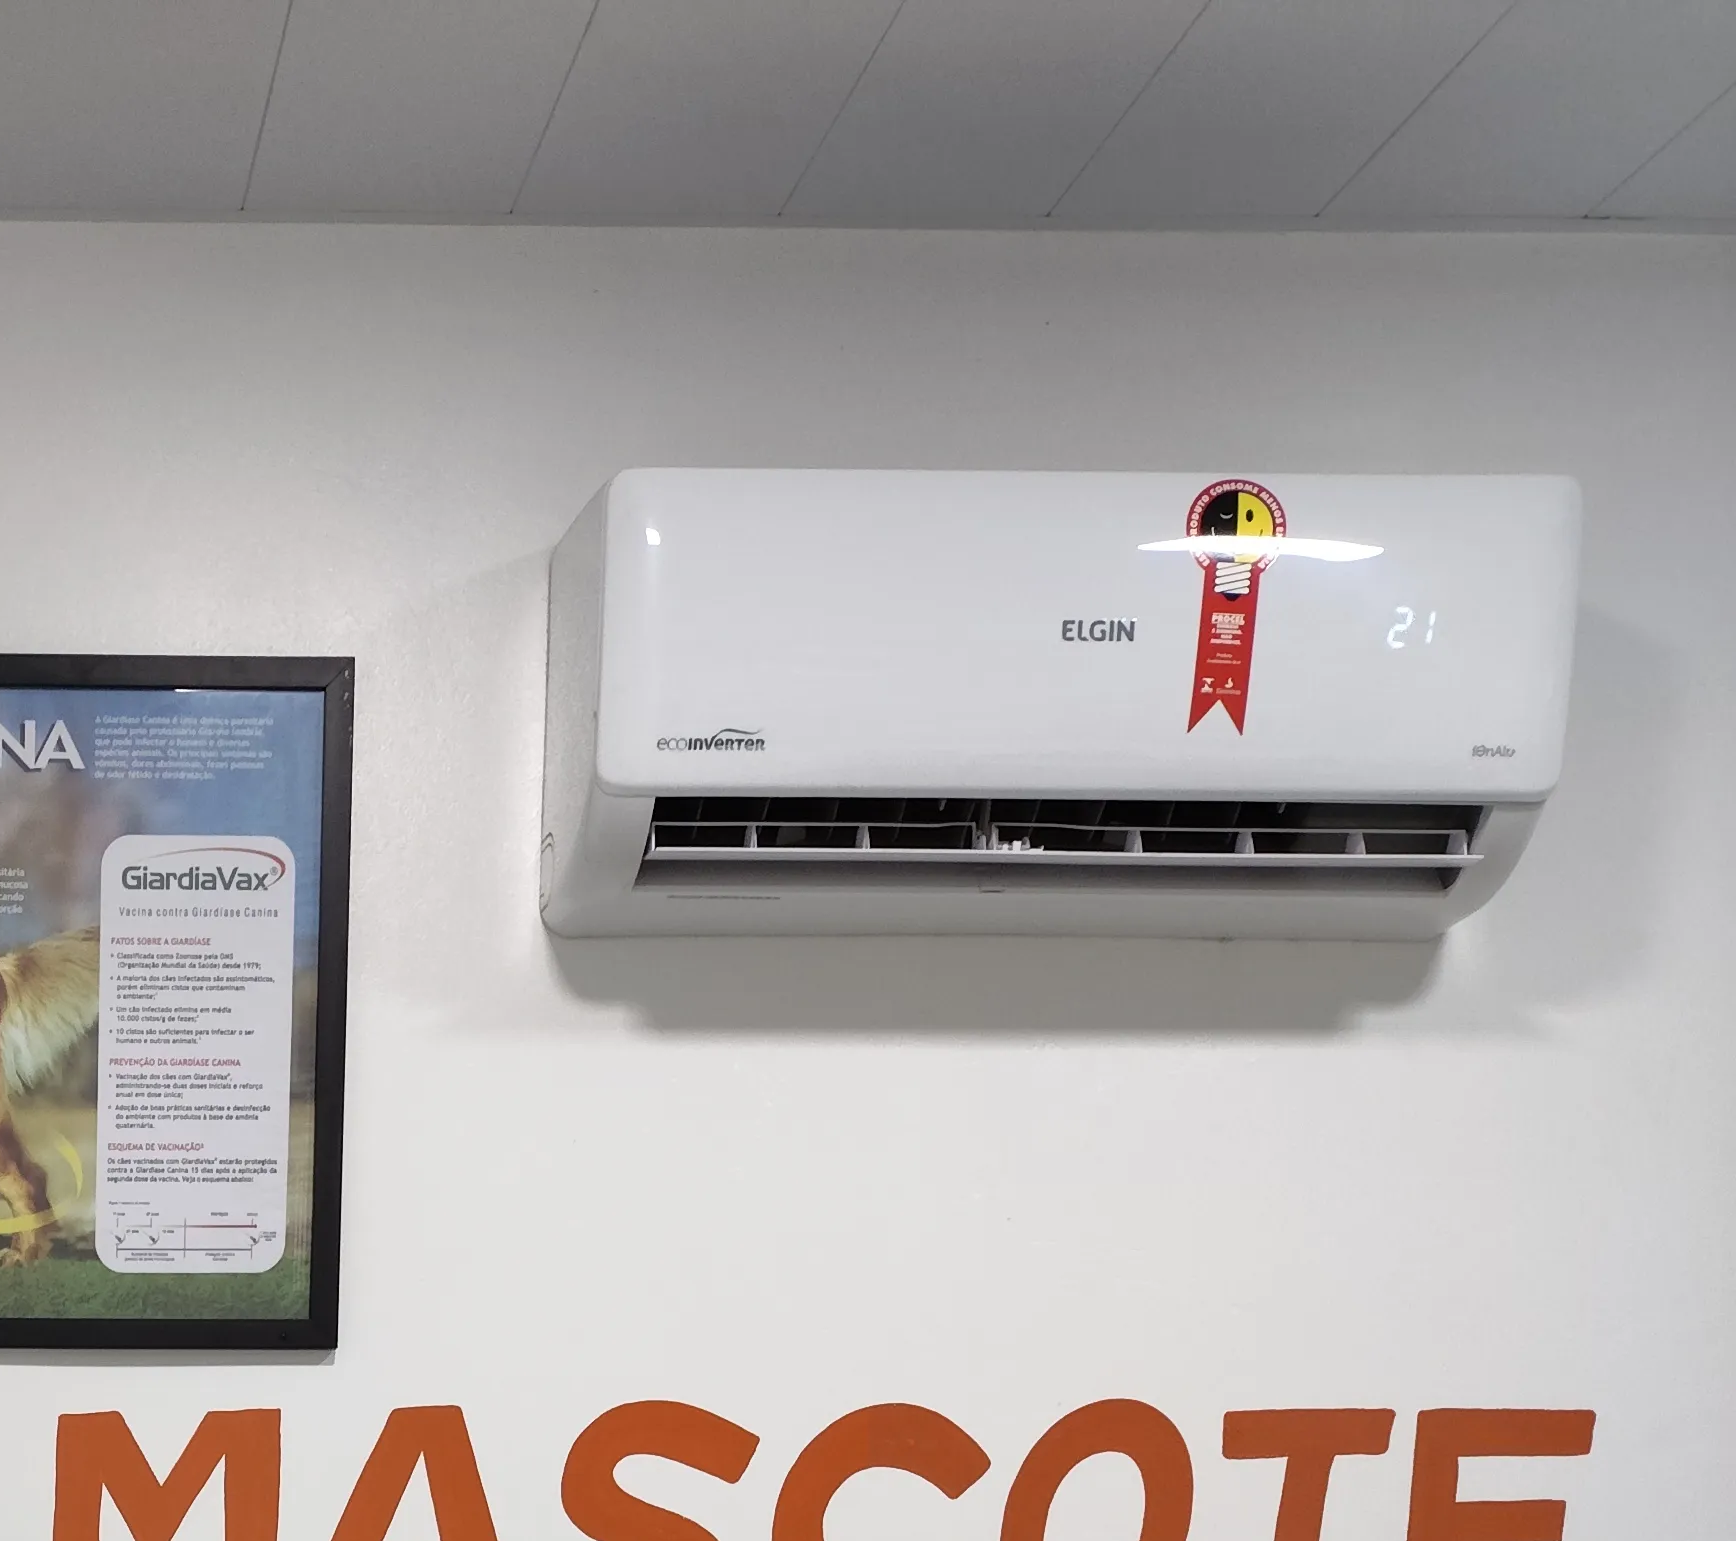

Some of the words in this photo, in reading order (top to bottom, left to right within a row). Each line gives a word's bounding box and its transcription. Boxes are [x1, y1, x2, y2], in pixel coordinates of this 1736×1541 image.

[1190, 494, 1209, 539] RODUTO
[1210, 482, 1259, 496] CONSOME
[1259, 492, 1284, 523] MENOS
[1062, 620, 1136, 642] ELGIN
[1386, 606, 1436, 649] 21
[119, 907, 152, 917] Vacina
[156, 907, 188, 917] contra
[244, 907, 278, 917] Canina
[111, 937, 134, 945] FATOS
[137, 937, 161, 945] SOBRE
[109, 1057, 155, 1067] PREVENÇÃO
[212, 1059, 241, 1067] CANINA
[108, 1143, 143, 1151] ESQUEMA
[146, 1143, 155, 1151] DE
